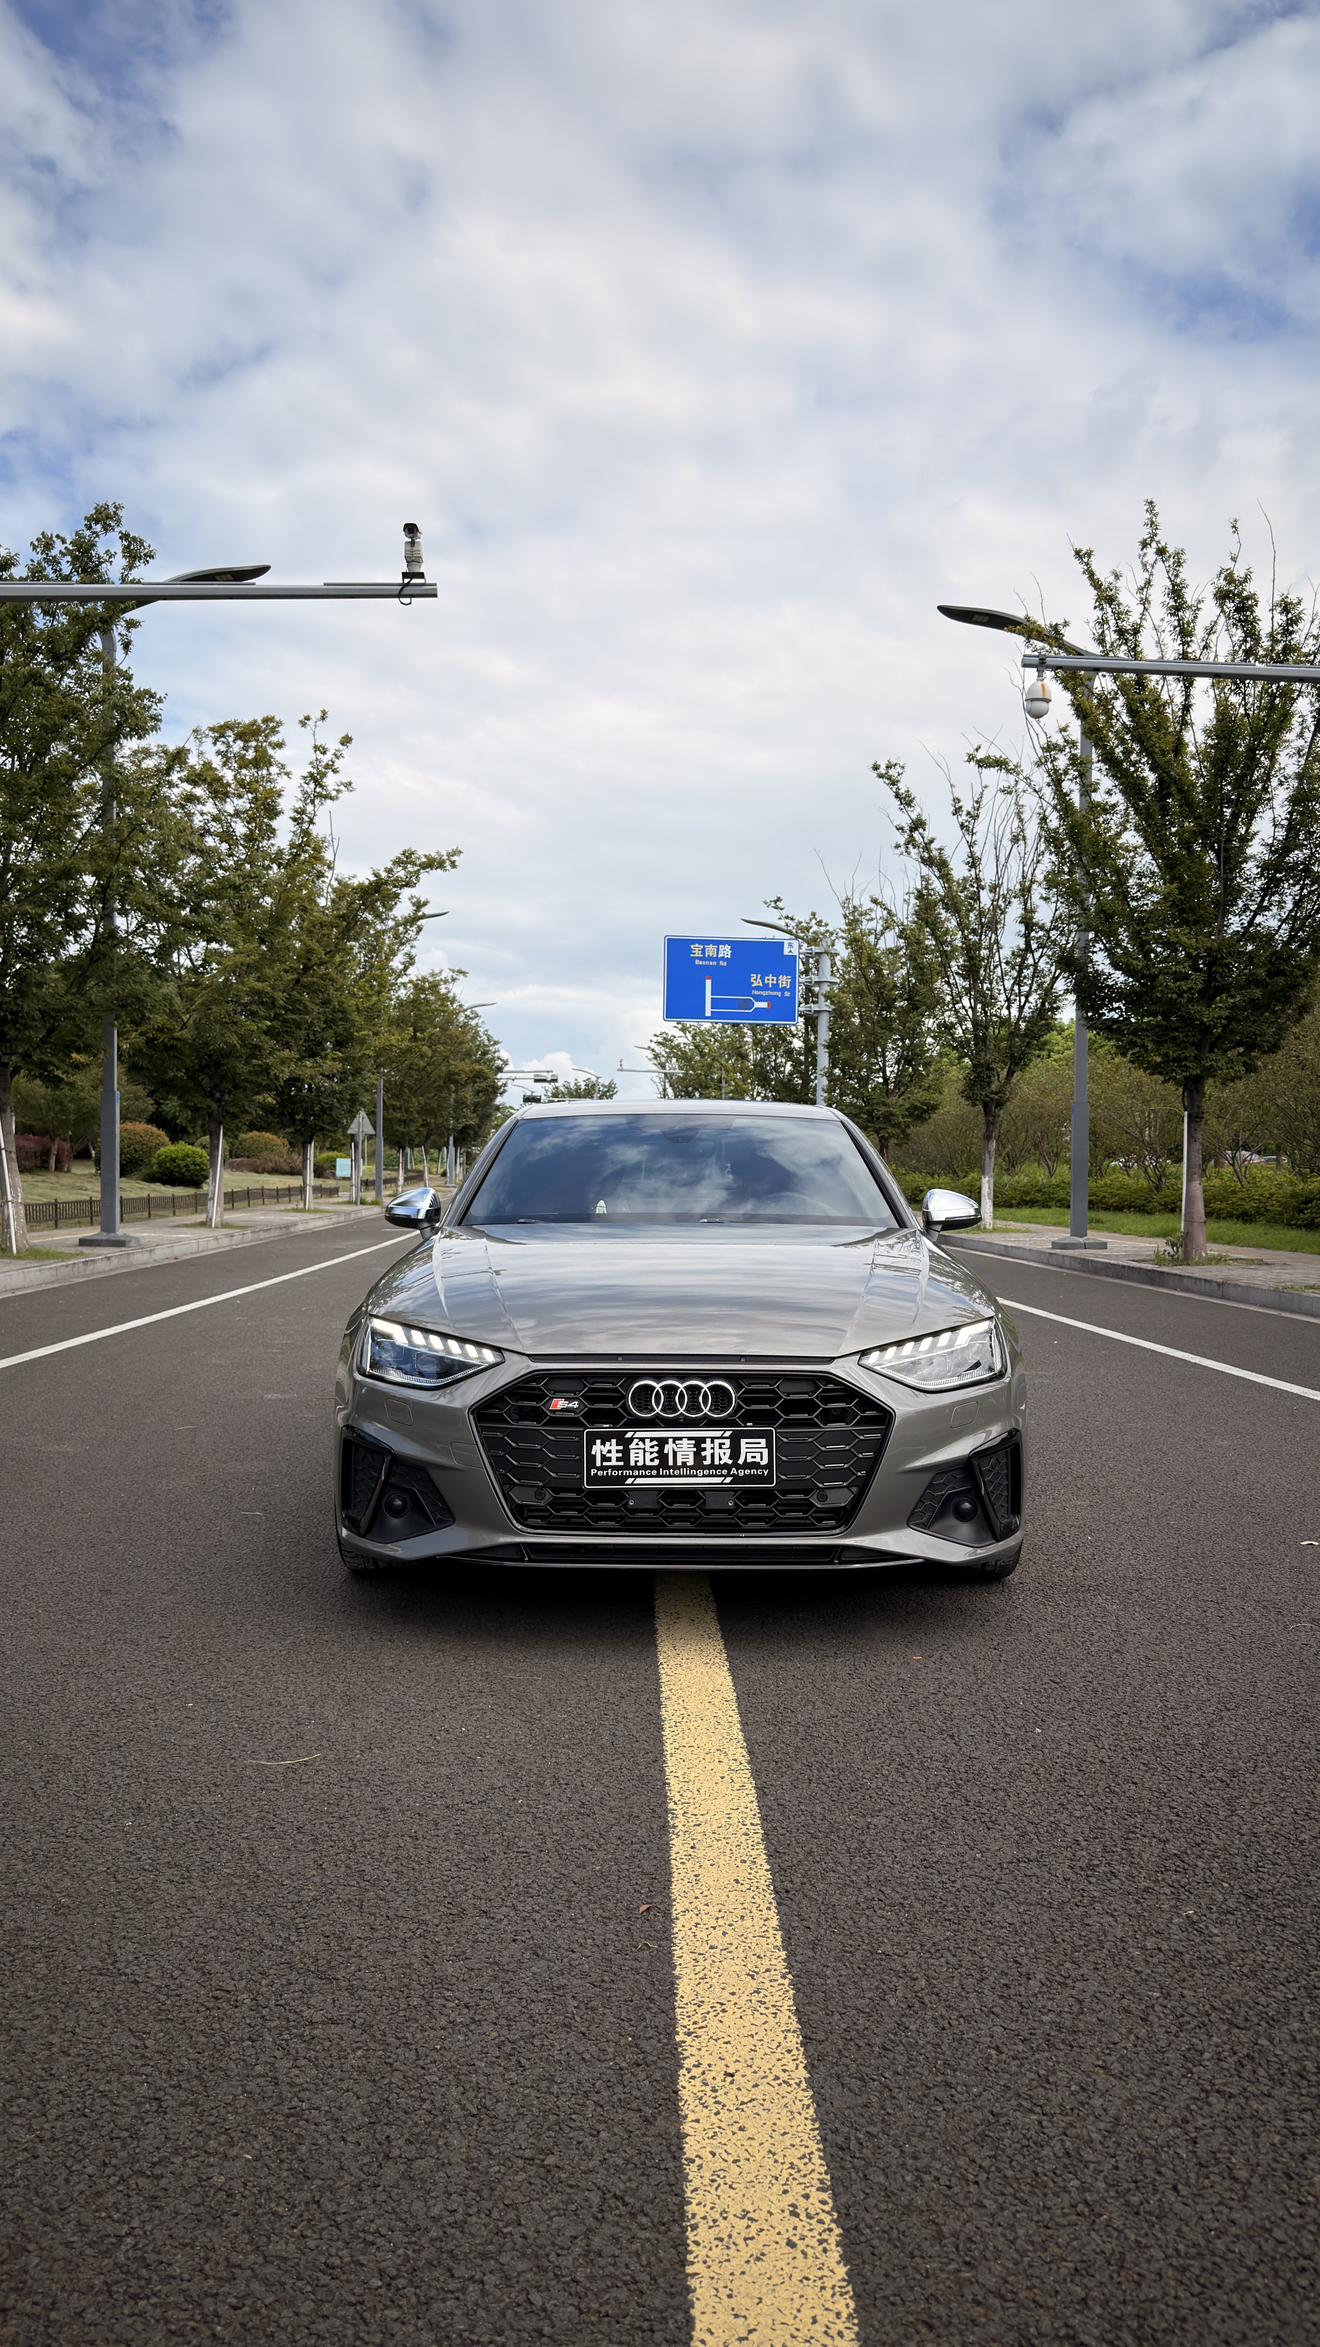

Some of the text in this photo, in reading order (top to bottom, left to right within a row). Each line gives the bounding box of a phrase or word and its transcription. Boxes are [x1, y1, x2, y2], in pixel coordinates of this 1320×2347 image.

[690, 944, 732, 958] 宝南路
[750, 974, 791, 988] 弘中街
[553, 1399, 579, 1409] S4
[591, 1438, 769, 1467] 性能情报局
[591, 1467, 769, 1477] Performance Intellingence Agency
